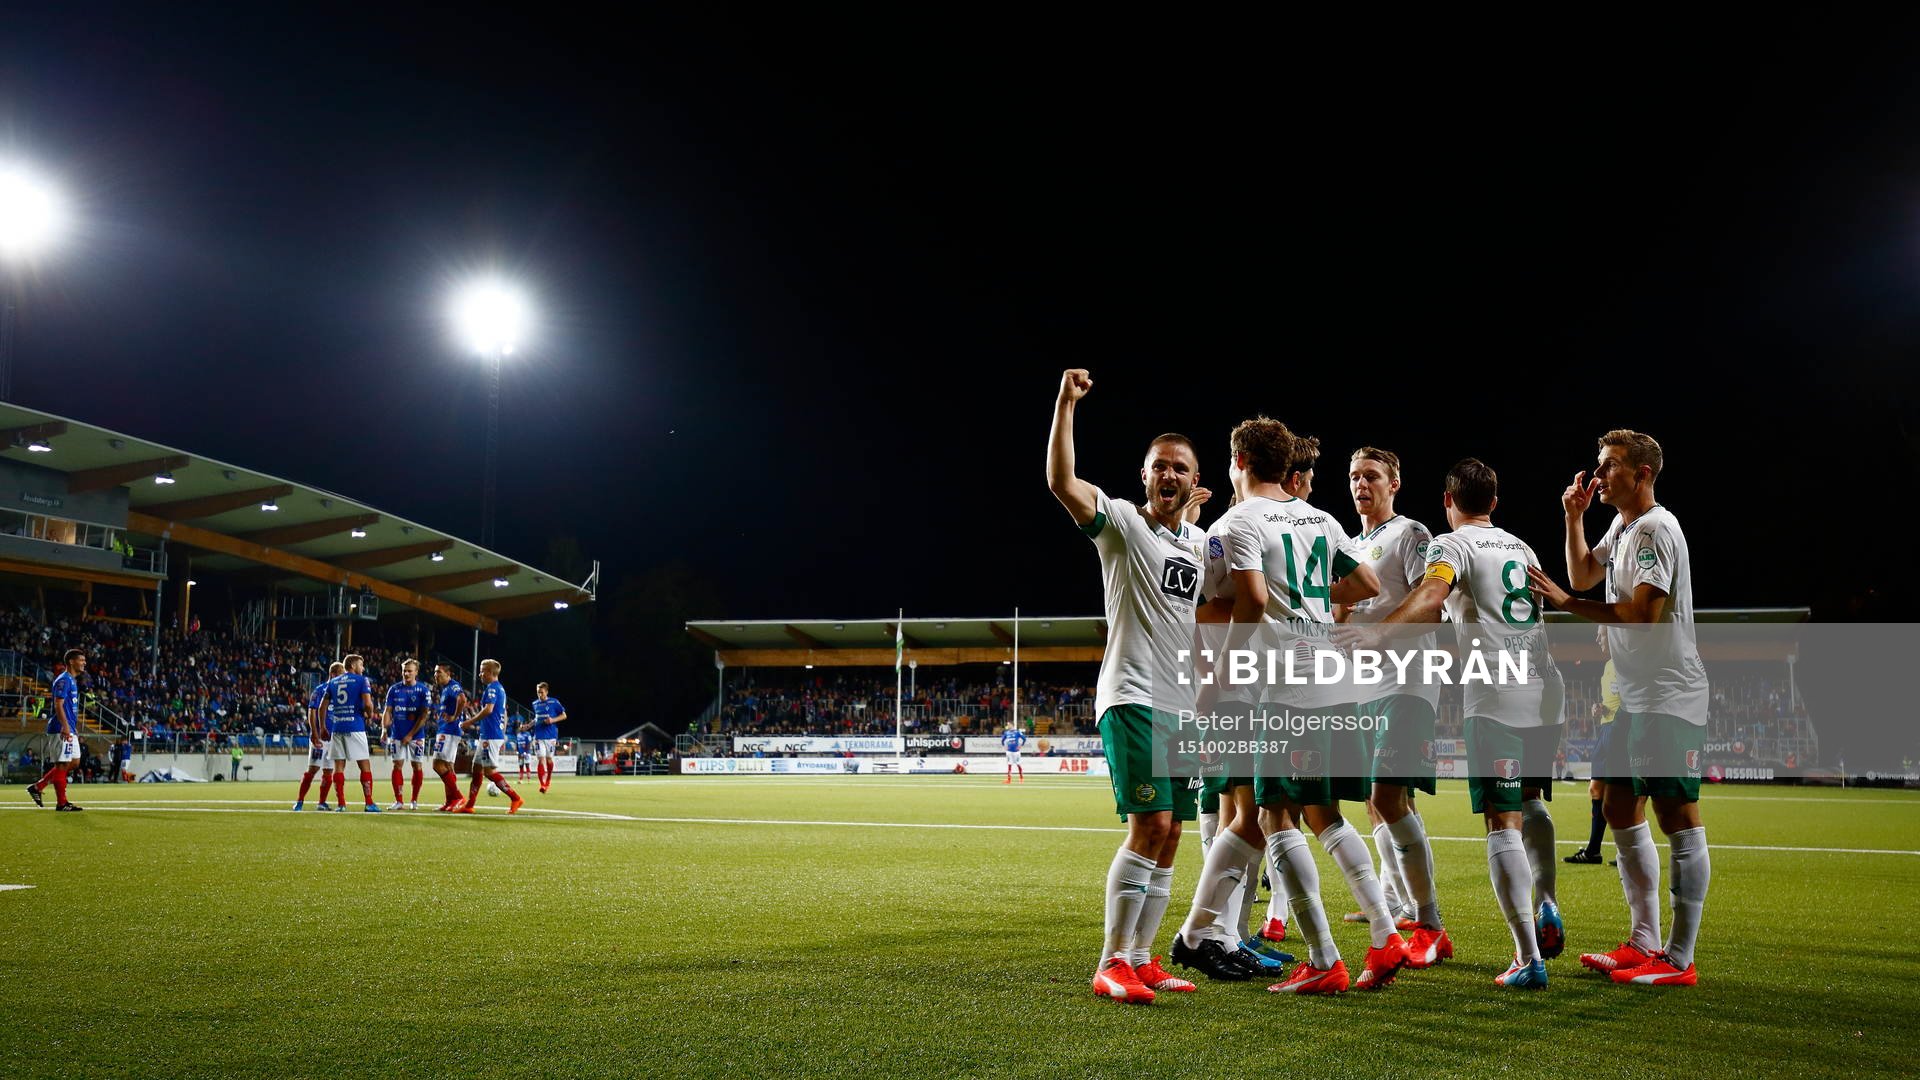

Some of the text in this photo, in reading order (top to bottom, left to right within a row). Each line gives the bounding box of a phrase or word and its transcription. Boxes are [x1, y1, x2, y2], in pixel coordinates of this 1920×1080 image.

[1281, 533, 1330, 613] 14
[1502, 560, 1539, 631] 8
[337, 684, 348, 705] 5
[741, 743, 765, 752] NCC
[784, 743, 807, 752] NCC
[906, 736, 950, 749] uhlsport
[698, 760, 766, 771] TIPS ELIT
[1059, 758, 1089, 772] ABB
